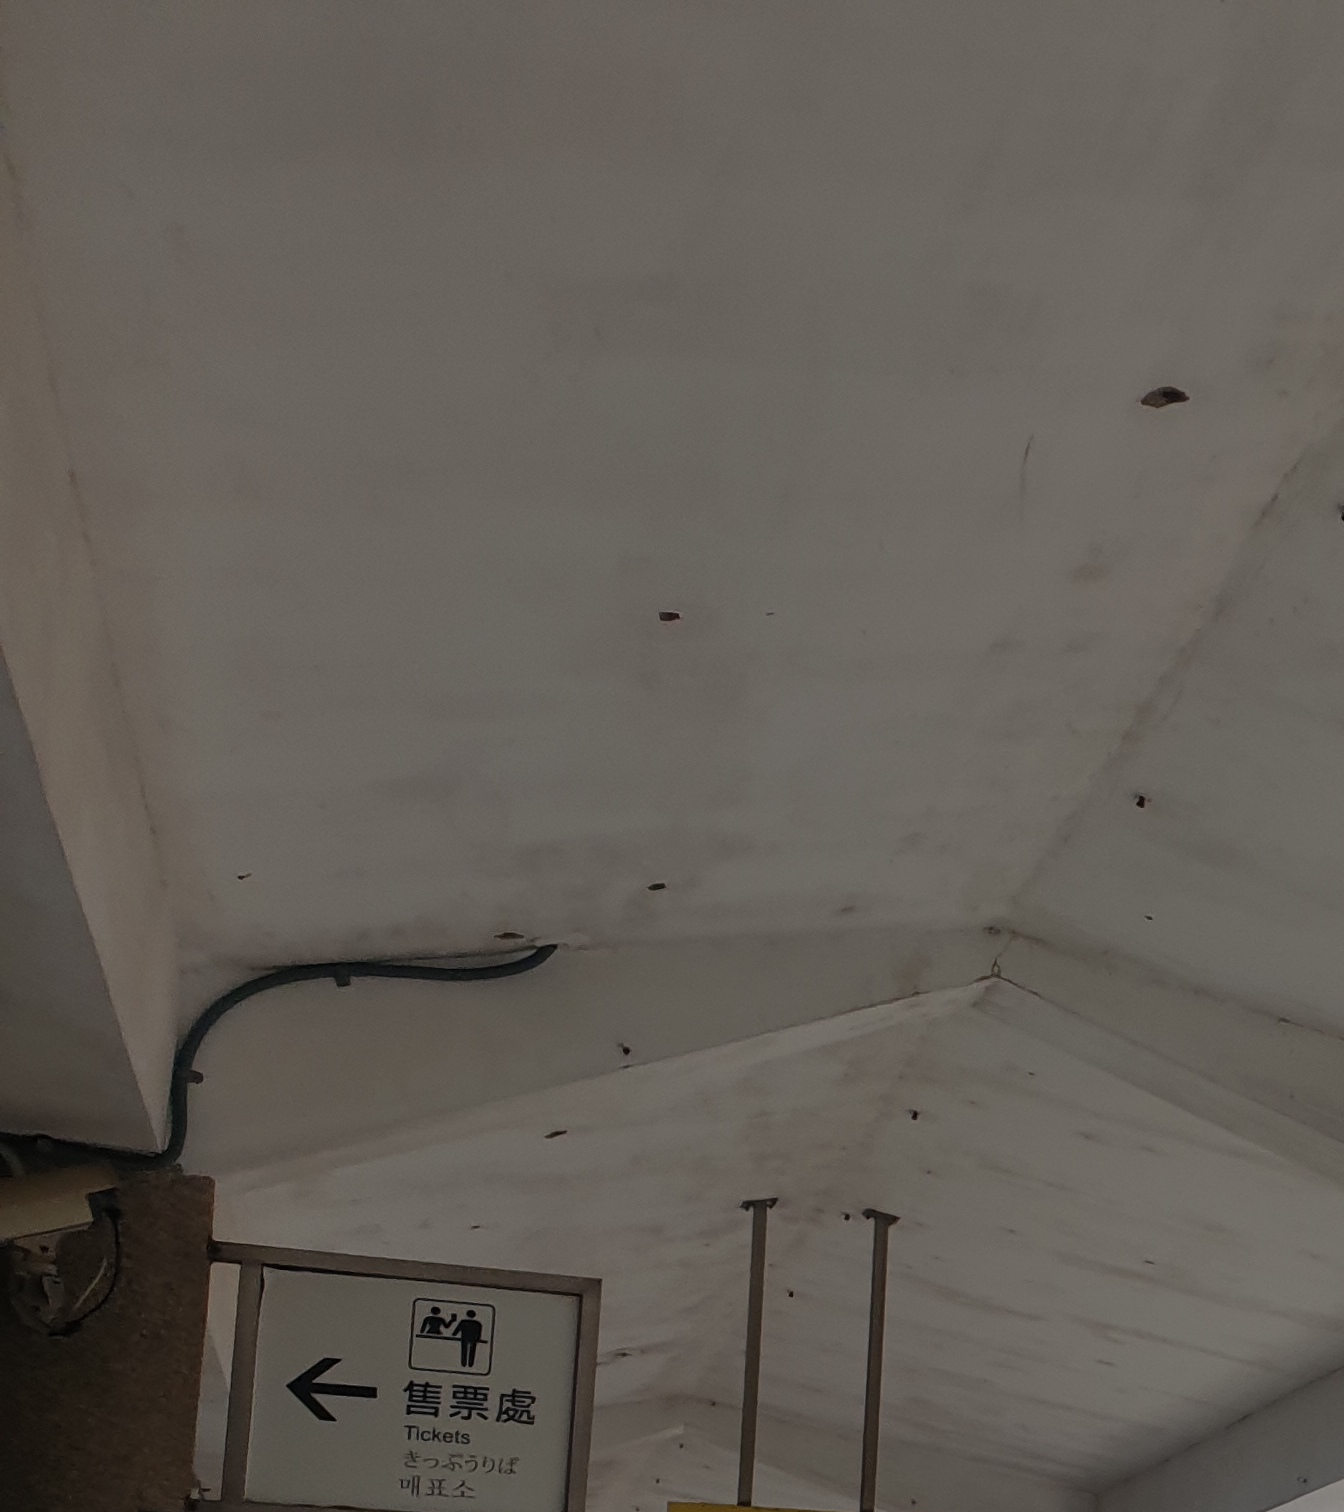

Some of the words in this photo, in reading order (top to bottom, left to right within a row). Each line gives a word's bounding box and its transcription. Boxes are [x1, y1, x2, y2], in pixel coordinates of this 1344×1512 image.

[403, 1380, 537, 1425] 售票處
[404, 1425, 471, 1446] Tickets
[399, 1475, 476, 1499] 매표소
